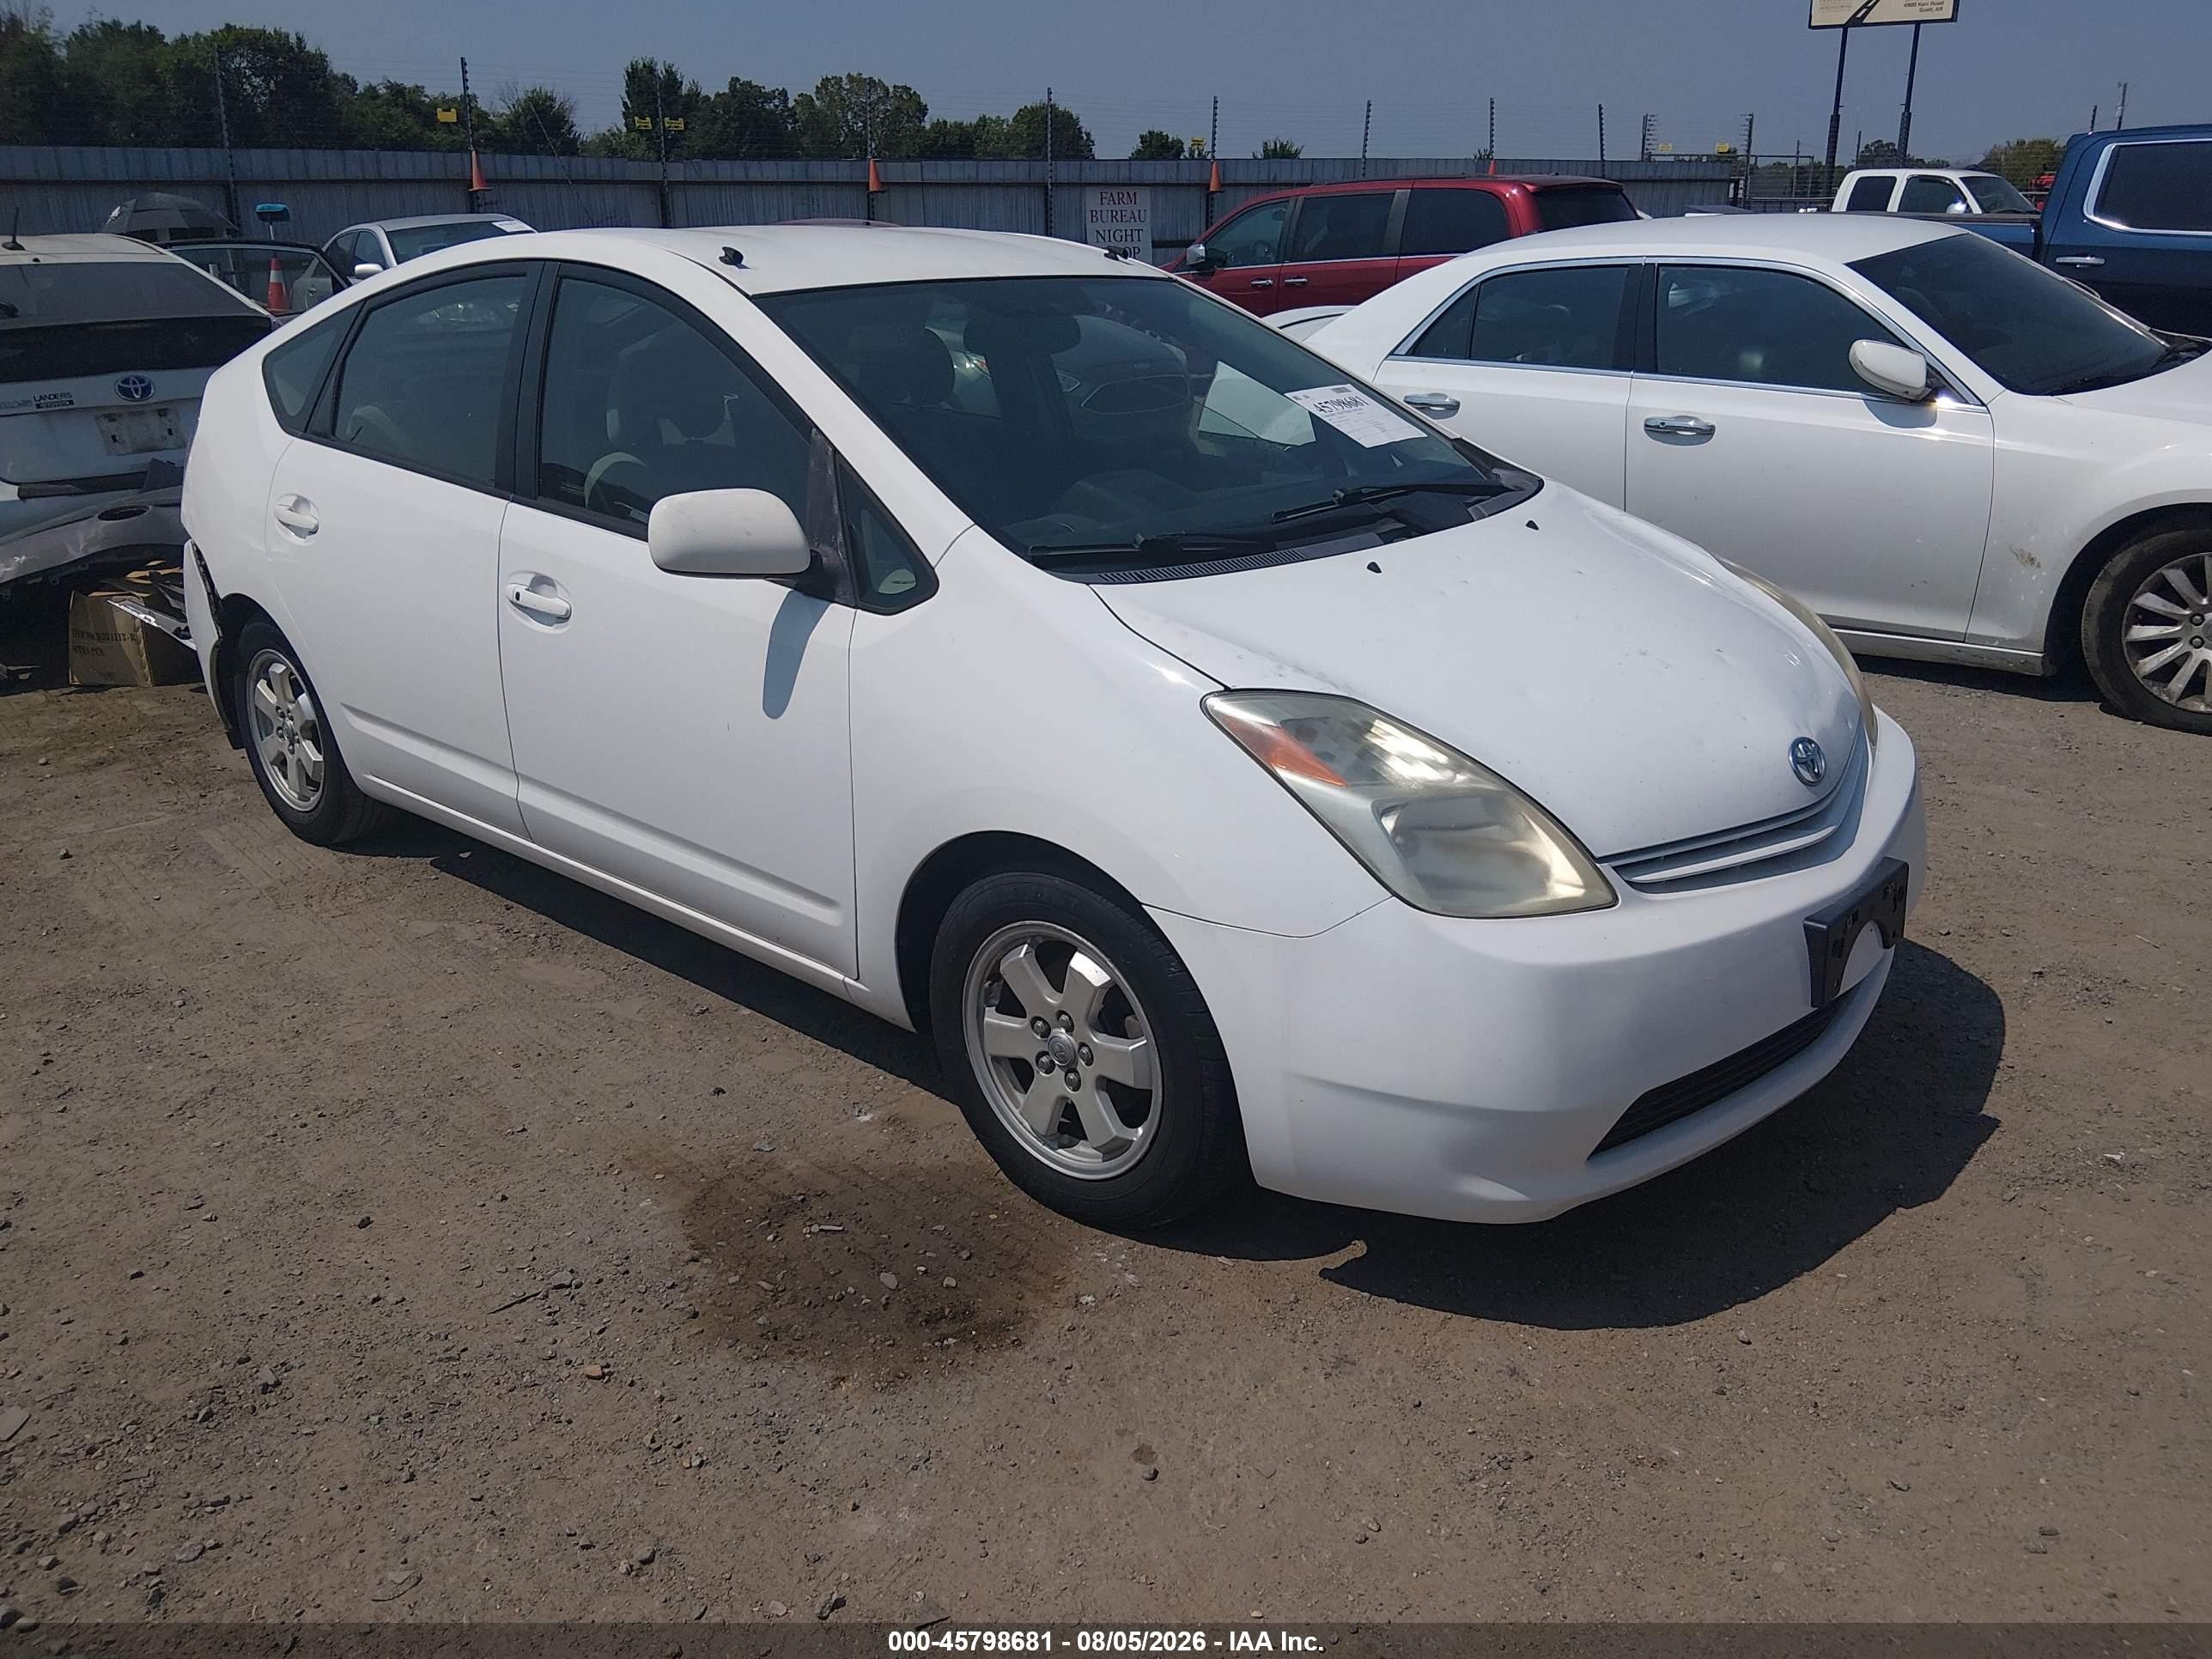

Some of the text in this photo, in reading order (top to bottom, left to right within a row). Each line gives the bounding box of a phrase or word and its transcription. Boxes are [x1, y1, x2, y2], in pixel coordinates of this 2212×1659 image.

[1100, 191, 1138, 205] FARM
[1090, 210, 1146, 223] BUREAU
[1096, 228, 1144, 242] NIGHT
[33, 392, 73, 402] LANDERS
[1313, 396, 1370, 414] 45798681
